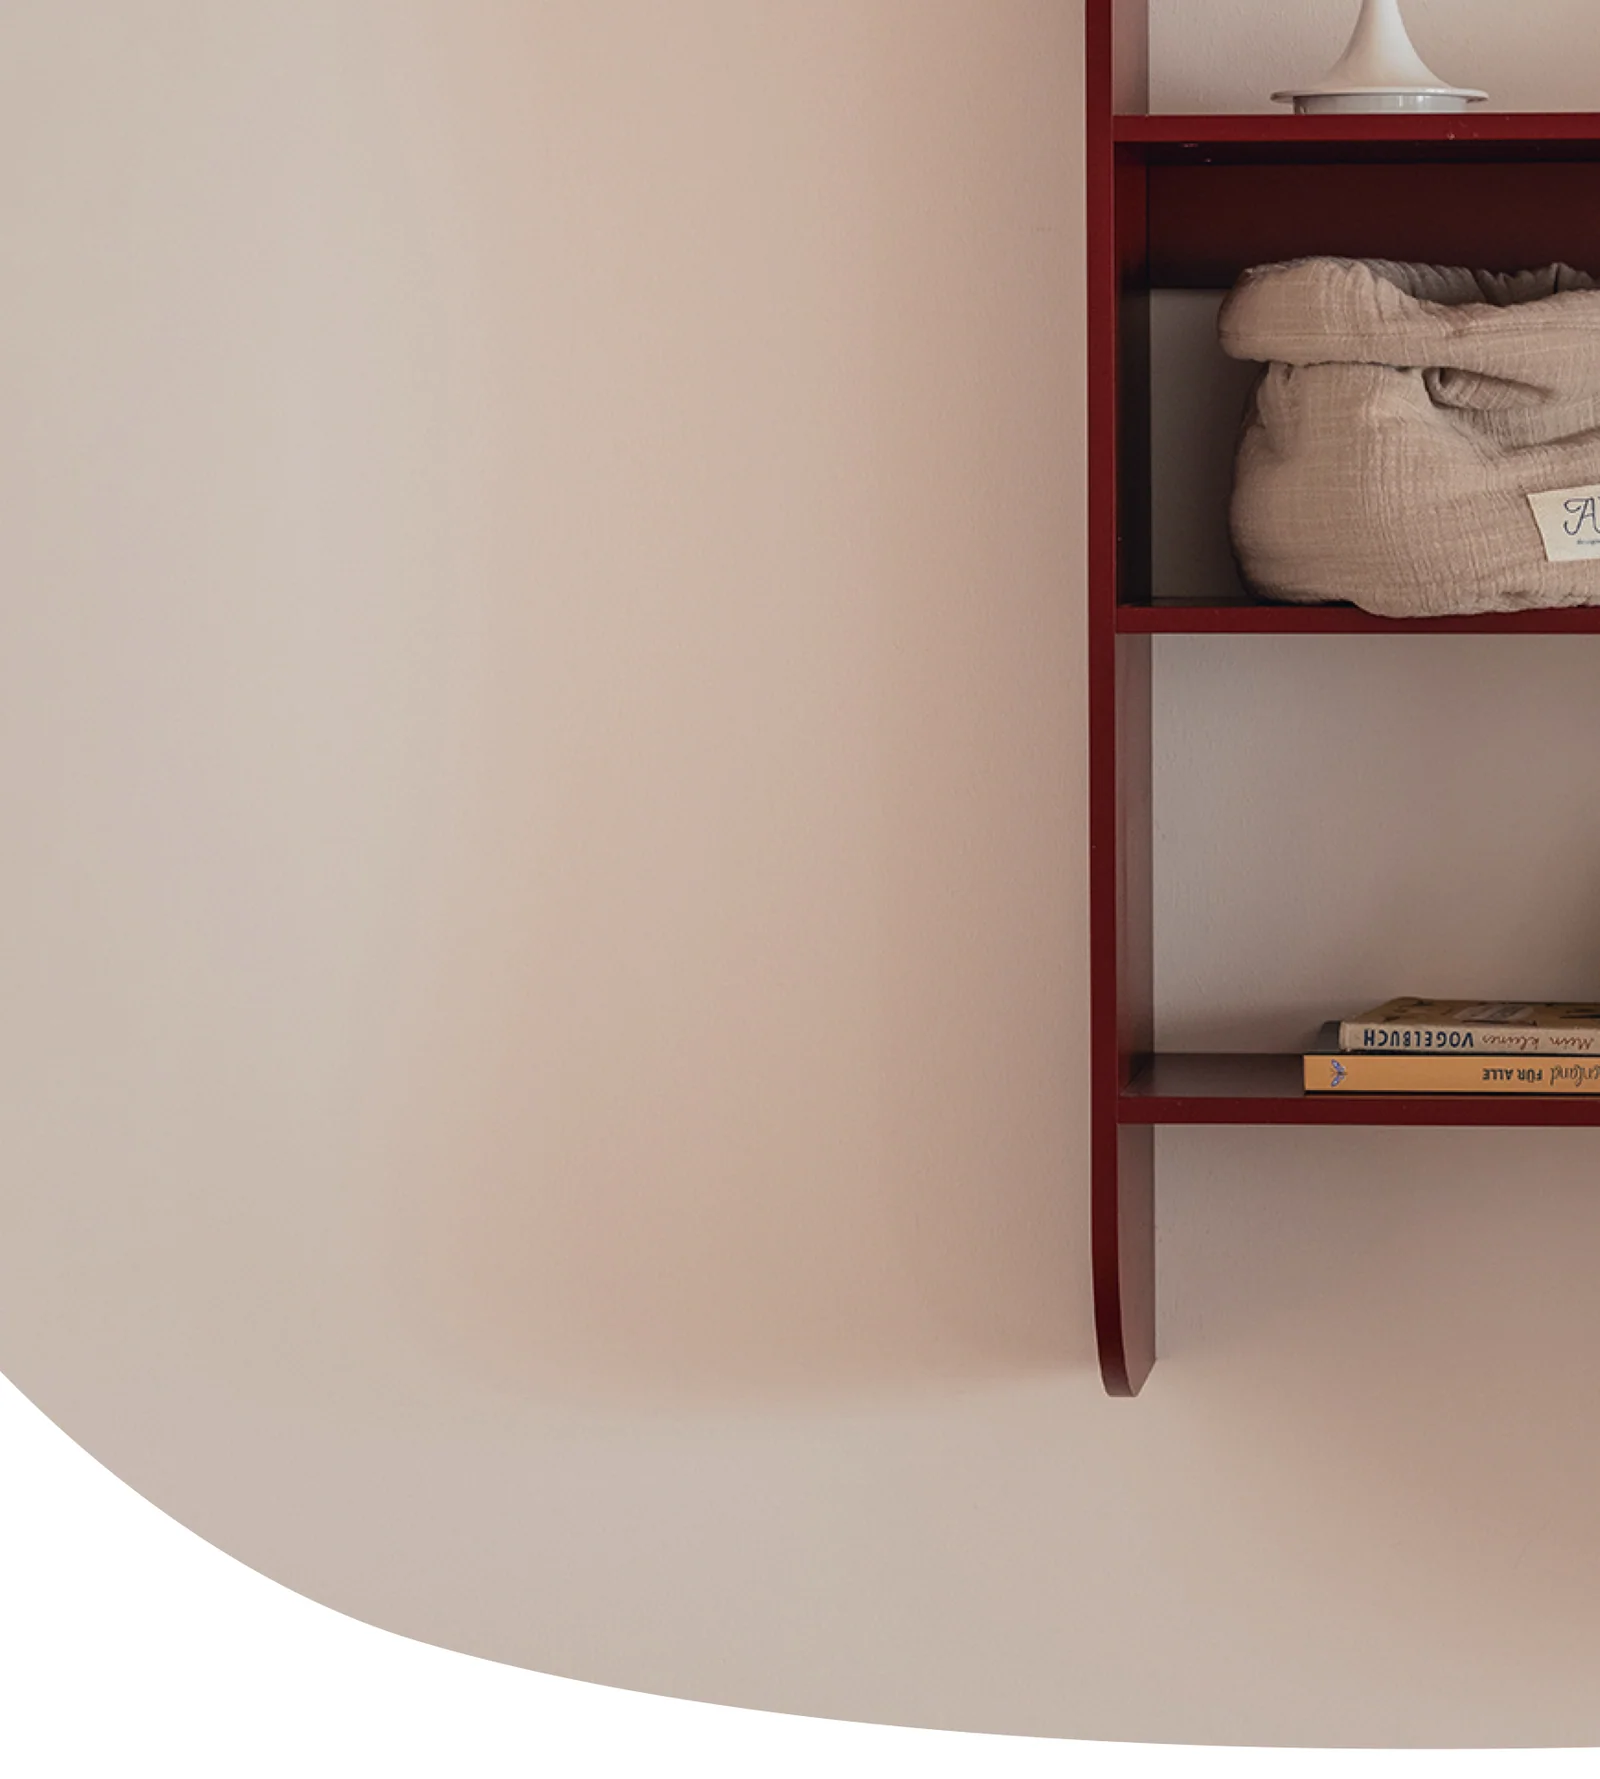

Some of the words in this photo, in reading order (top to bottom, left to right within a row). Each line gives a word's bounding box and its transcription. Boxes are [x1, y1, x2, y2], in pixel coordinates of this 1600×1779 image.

[1363, 1028, 1474, 1048] VOGELBUCH
[1482, 1033, 1540, 1050] kleines
[1549, 1036, 1595, 1051] Mein
[1482, 1068, 1513, 1081] ALLE
[1516, 1068, 1543, 1081] FÜR
